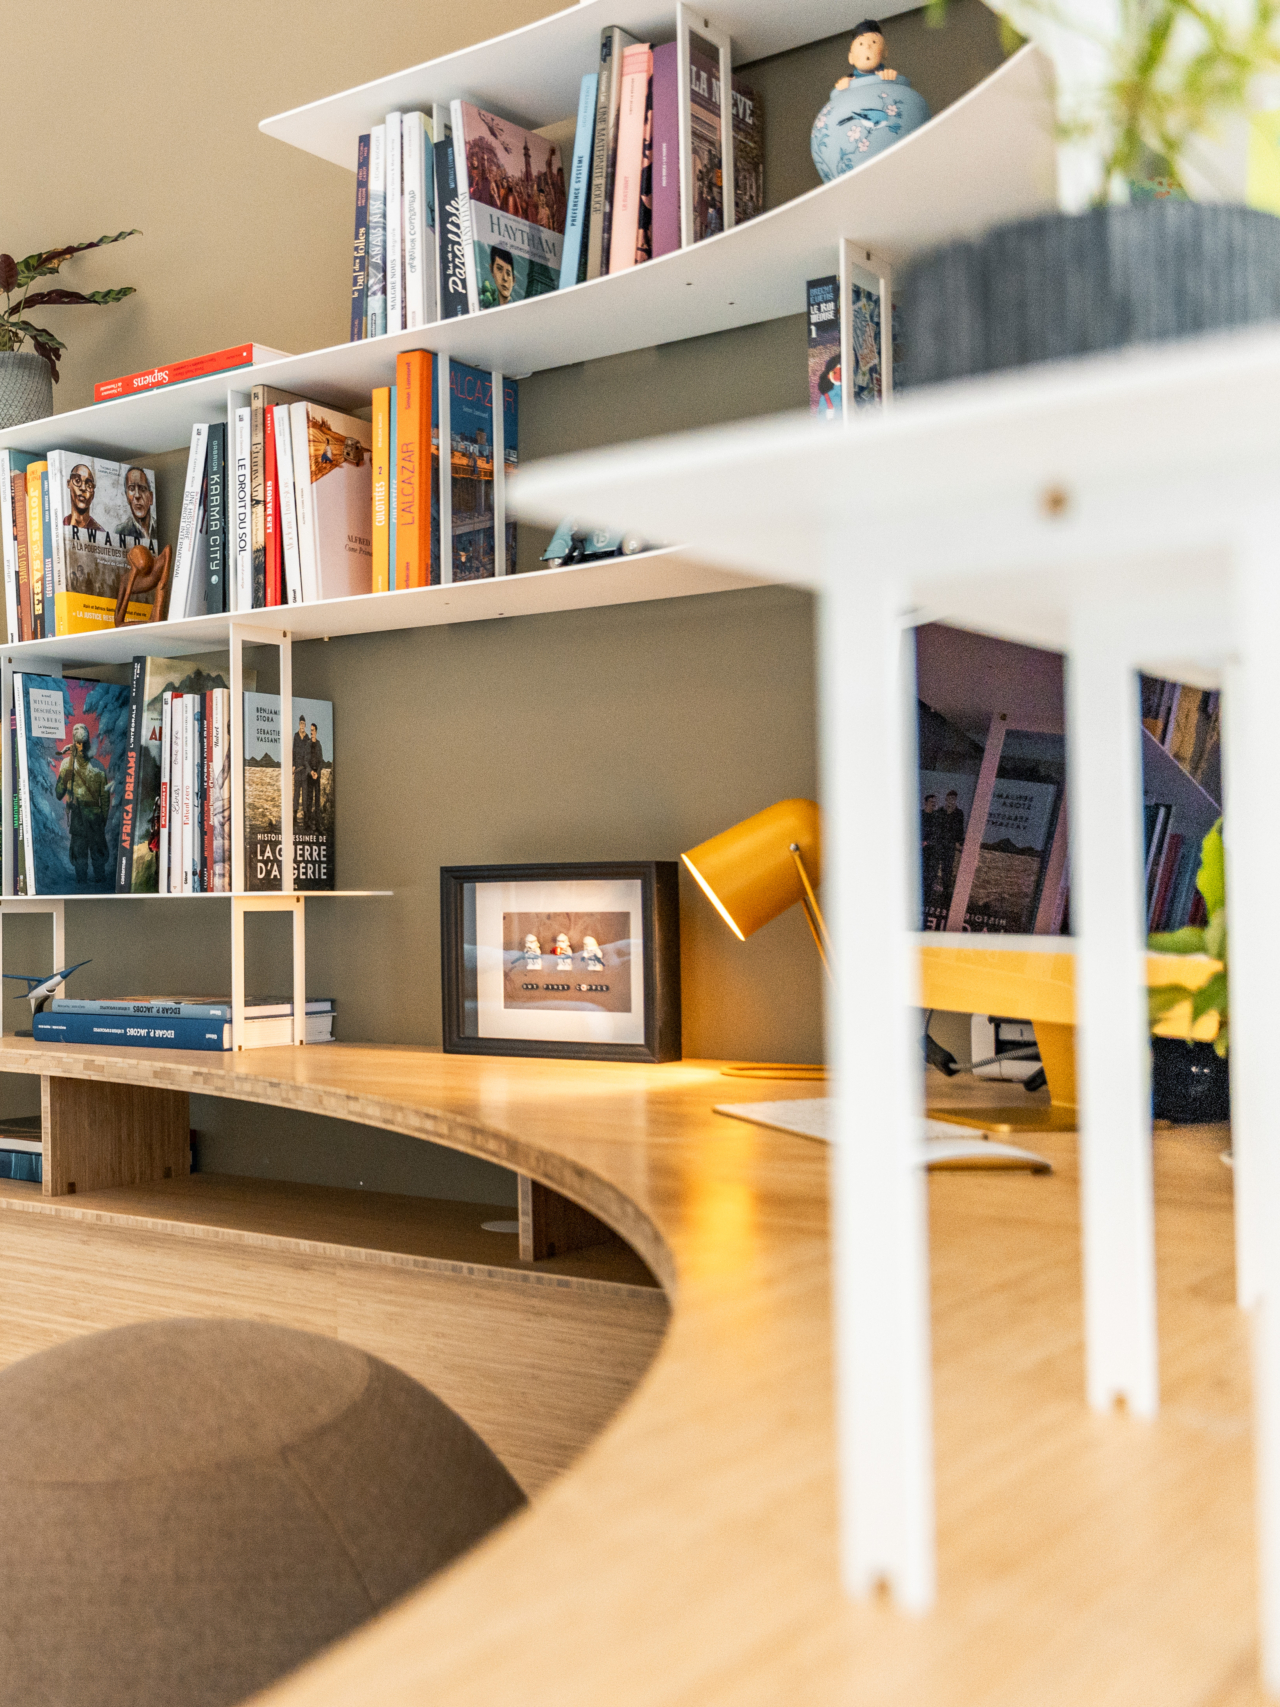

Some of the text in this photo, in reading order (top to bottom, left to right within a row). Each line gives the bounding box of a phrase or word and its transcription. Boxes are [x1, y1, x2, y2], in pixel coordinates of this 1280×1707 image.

[690, 64, 753, 125] LA NEVE
[598, 106, 608, 125] UNE
[570, 155, 584, 227] PRÉFÉRENCE SYSTÈME
[591, 183, 602, 215] ROUGE
[371, 199, 384, 221] NIN
[353, 226, 367, 256] folles
[407, 189, 417, 273] OPÉRATION COPPERHEAD
[489, 213, 557, 257] HAYTHAM
[445, 197, 466, 294] Parallèle
[352, 271, 365, 290] bal
[389, 258, 397, 310] MALGRÉ NOUS
[352, 290, 359, 298] le
[810, 301, 835, 315] LE ROI
[810, 325, 817, 338] 1
[133, 369, 169, 388] Sapiens
[449, 370, 515, 414] ALCAZR
[401, 441, 416, 528] L'ALCAZAR
[210, 474, 220, 531] KARMA
[237, 457, 247, 556] LE DROIT DU SOL
[374, 480, 385, 527] CULOTTÉES
[16, 501, 25, 541] BALTHAZAR
[184, 491, 196, 541] UNE HISTOIRE
[72, 525, 156, 554] RWANDA
[174, 490, 190, 579] DU DROIT INTERNATIONAL
[347, 534, 370, 547] ALFRED
[17, 544, 26, 556] LES
[30, 487, 43, 615] JOURS SABLE
[71, 541, 121, 558] À LA POURSUITE DES
[210, 535, 220, 570] CITY
[344, 543, 358, 553] Come
[18, 557, 28, 584] LOUVES
[45, 558, 53, 598] GÉOSTRATÉGIX
[76, 610, 102, 621] LA JUSTICE
[33, 707, 62, 715] DESCHÊNES
[34, 715, 62, 724] RUNBERG
[256, 706, 281, 716] BENJAMI
[256, 714, 274, 723] STORA
[213, 726, 221, 749] Hubert
[256, 728, 281, 737] SÉBASTIE
[256, 736, 281, 744] VASSANT
[121, 704, 137, 849] AFRICA DREAMS L'INTÉGRALE
[183, 802, 191, 826] Patient
[257, 833, 327, 843] HISTOIR ESSINÉE DE
[257, 843, 327, 861] LA GERRE
[257, 862, 327, 879] D'AGÉRIE
[132, 1004, 154, 1013] JACOBS
[161, 1005, 181, 1015] EDGAR
[126, 1027, 175, 1039] EDGAR P. JACOBS
